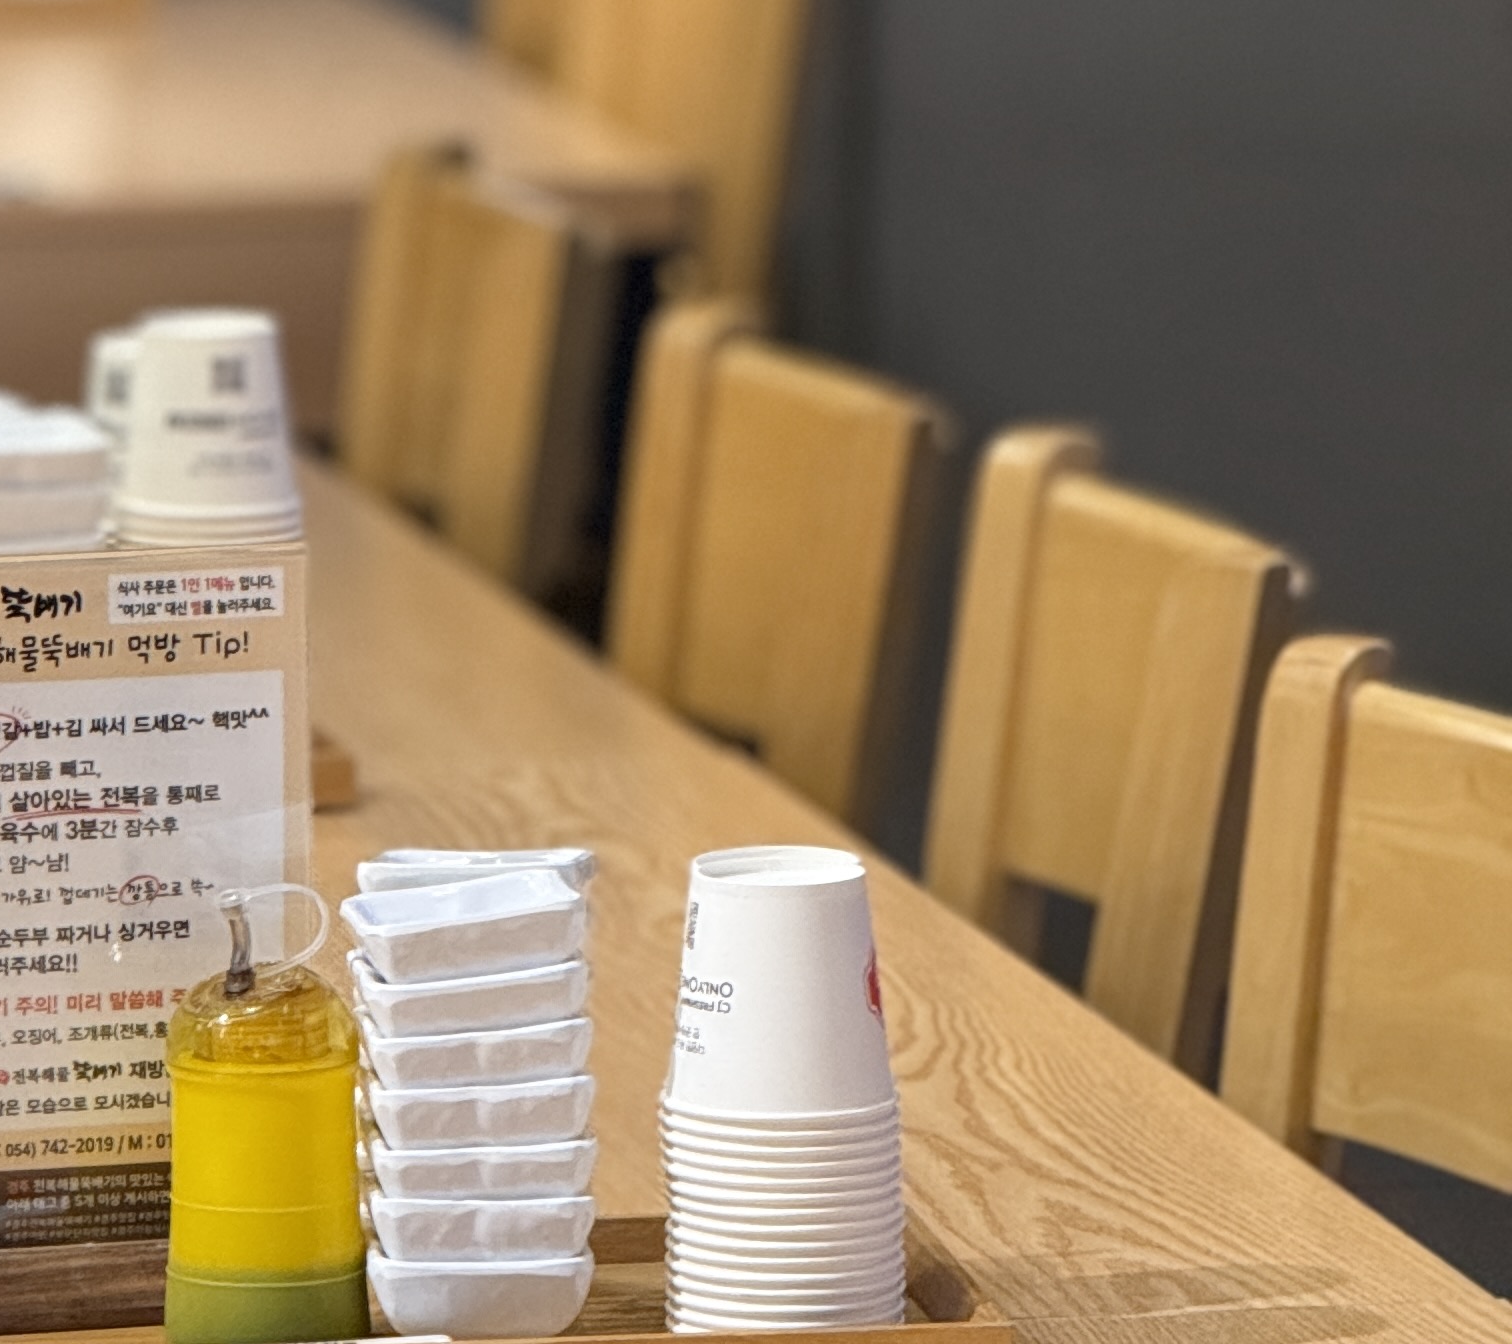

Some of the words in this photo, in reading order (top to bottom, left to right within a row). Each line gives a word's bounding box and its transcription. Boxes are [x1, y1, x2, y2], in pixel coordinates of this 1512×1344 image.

[117, 580, 140, 597] 식사
[143, 579, 177, 595] 주문은
[164, 600, 188, 616] 대신
[128, 633, 181, 665] 먹방
[192, 630, 250, 659] Tip!
[89, 715, 126, 736] 싸서
[132, 713, 205, 734] 드세요~
[59, 759, 102, 779] 빼고,
[8, 789, 92, 814] 살아있는
[100, 785, 160, 809] 전복을
[166, 784, 221, 806] 통째로
[65, 818, 117, 842] 3분간
[124, 816, 180, 838] 잠수후
[55, 922, 112, 945] 짜거나
[117, 919, 192, 942] 싱거우면
[14, 994, 59, 1016] 주의!
[66, 991, 102, 1013] 미리
[109, 988, 165, 1011] 말씀해
[10, 1027, 63, 1046] 오징어,
[25, 1095, 89, 1115] 모습으로
[39, 1136, 114, 1156] 742-2019
